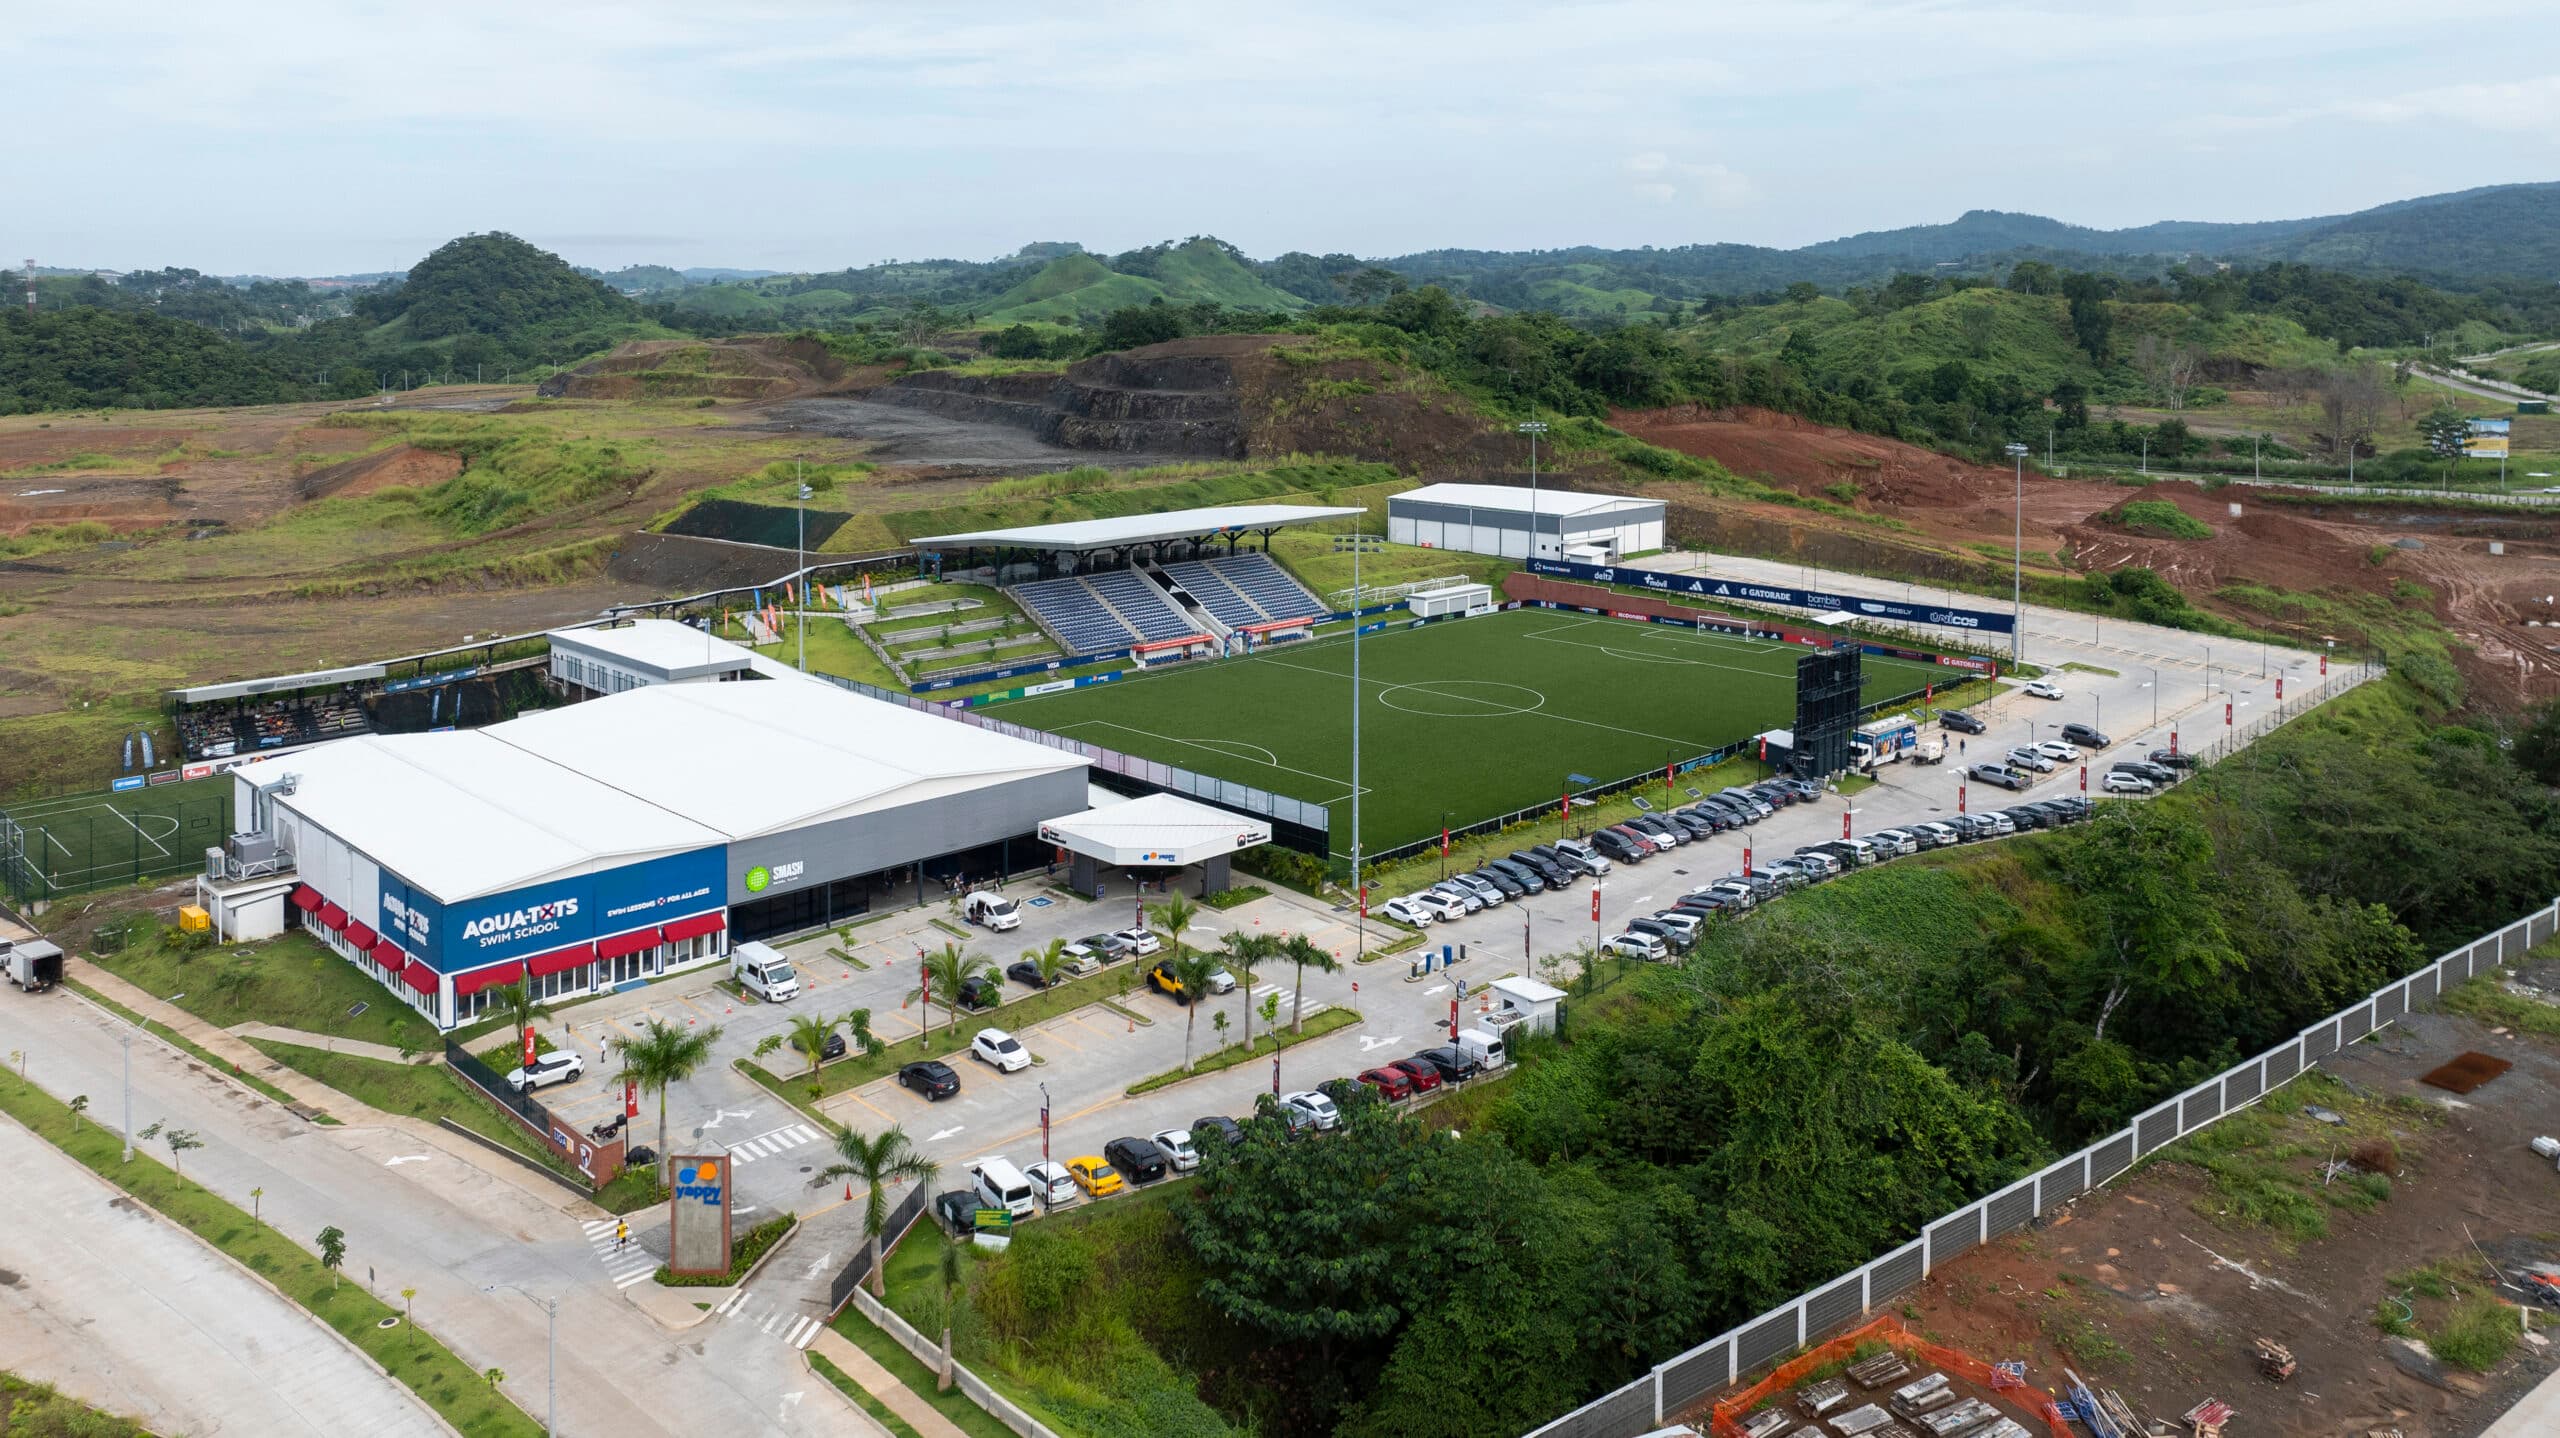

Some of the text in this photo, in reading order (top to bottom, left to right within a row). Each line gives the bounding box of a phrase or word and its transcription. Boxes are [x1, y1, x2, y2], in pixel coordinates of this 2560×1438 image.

[1594, 571, 1613, 581] delta
[1748, 588, 1791, 601] GATORADE
[1886, 606, 1912, 615] GEELY
[1951, 659, 1985, 669] GATORADE
[773, 860, 804, 880] SMASH
[607, 887, 710, 918] SWIM LESSONS FOR ALL AGES
[480, 921, 560, 948] SWIM SCHOOL
[675, 1186, 721, 1201] yappy
